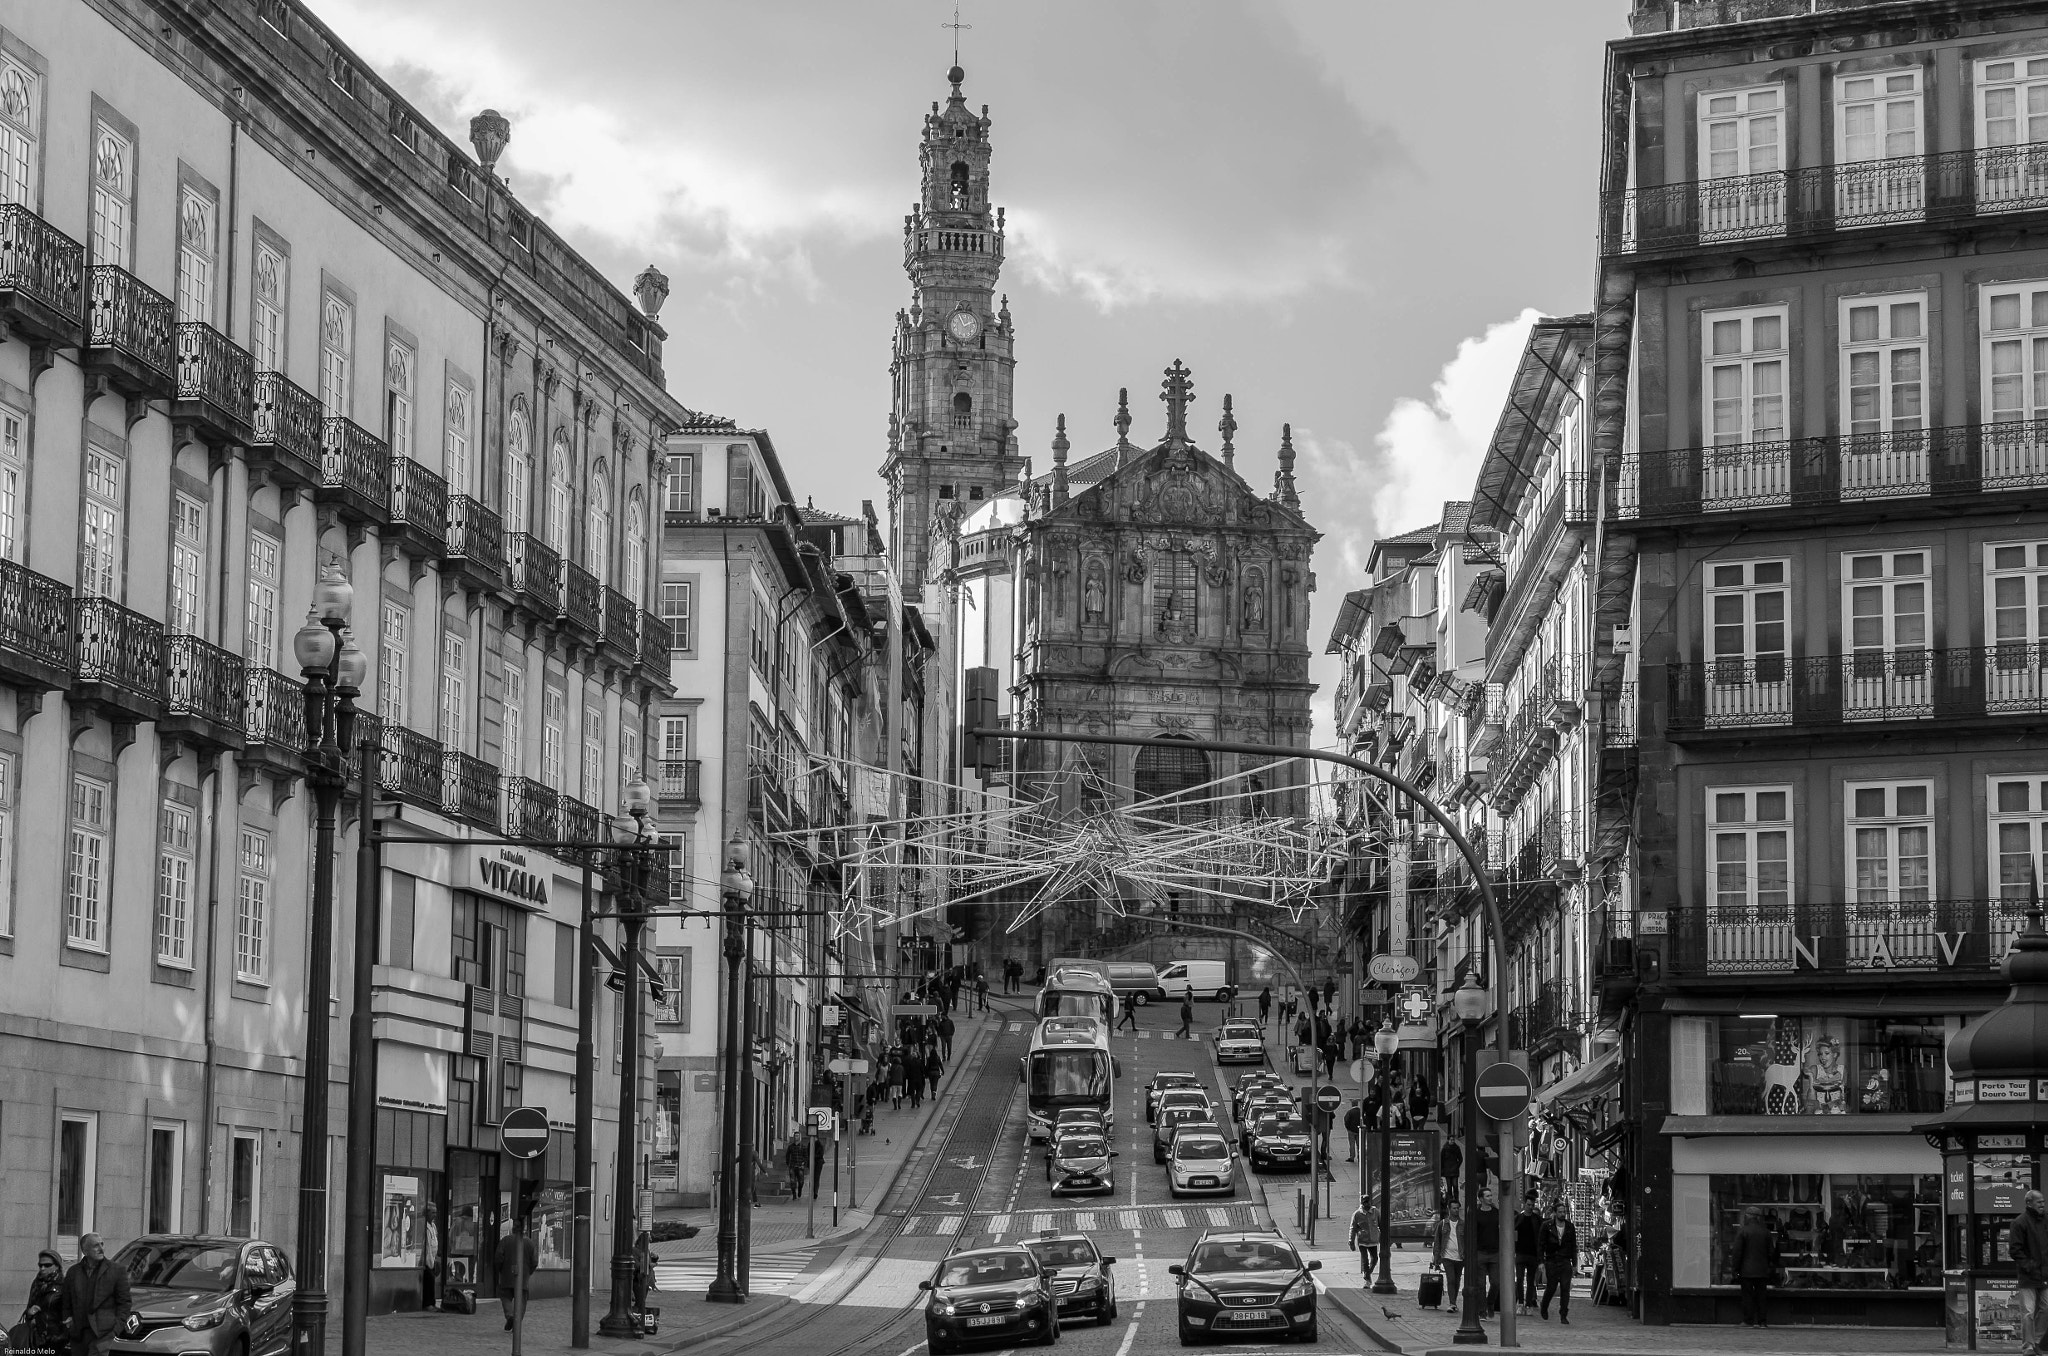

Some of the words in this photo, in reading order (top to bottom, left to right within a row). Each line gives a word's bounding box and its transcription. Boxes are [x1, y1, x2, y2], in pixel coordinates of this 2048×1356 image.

[479, 857, 548, 904] VITALIA
[1950, 1171, 1964, 1183] ticket
[1950, 1188, 1964, 1200] office
